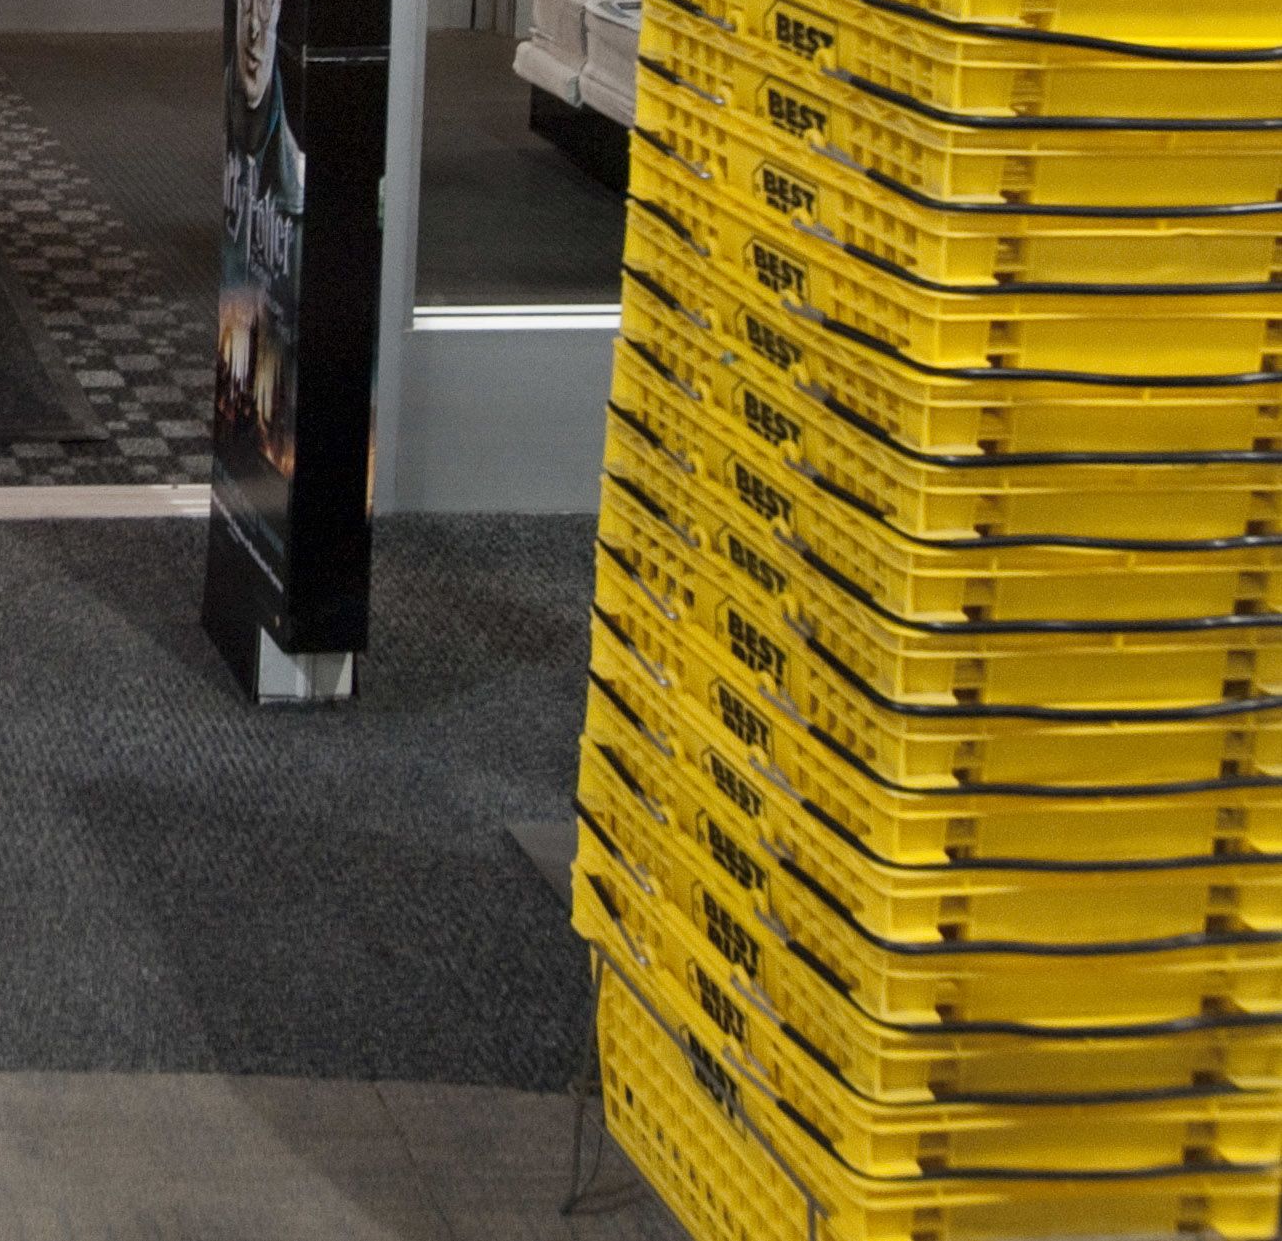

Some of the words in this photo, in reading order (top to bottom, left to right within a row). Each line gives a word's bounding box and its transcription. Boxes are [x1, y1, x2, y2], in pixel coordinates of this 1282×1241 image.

[776, 12, 834, 53] BEST
[769, 88, 826, 133] BEST
[763, 169, 815, 212] BEST
[754, 244, 804, 289] BEST
[747, 315, 802, 361] BEST
[744, 390, 801, 446] BEST
[736, 463, 792, 519] BEST
[729, 535, 786, 591] BEST
[728, 608, 786, 685] BEST
